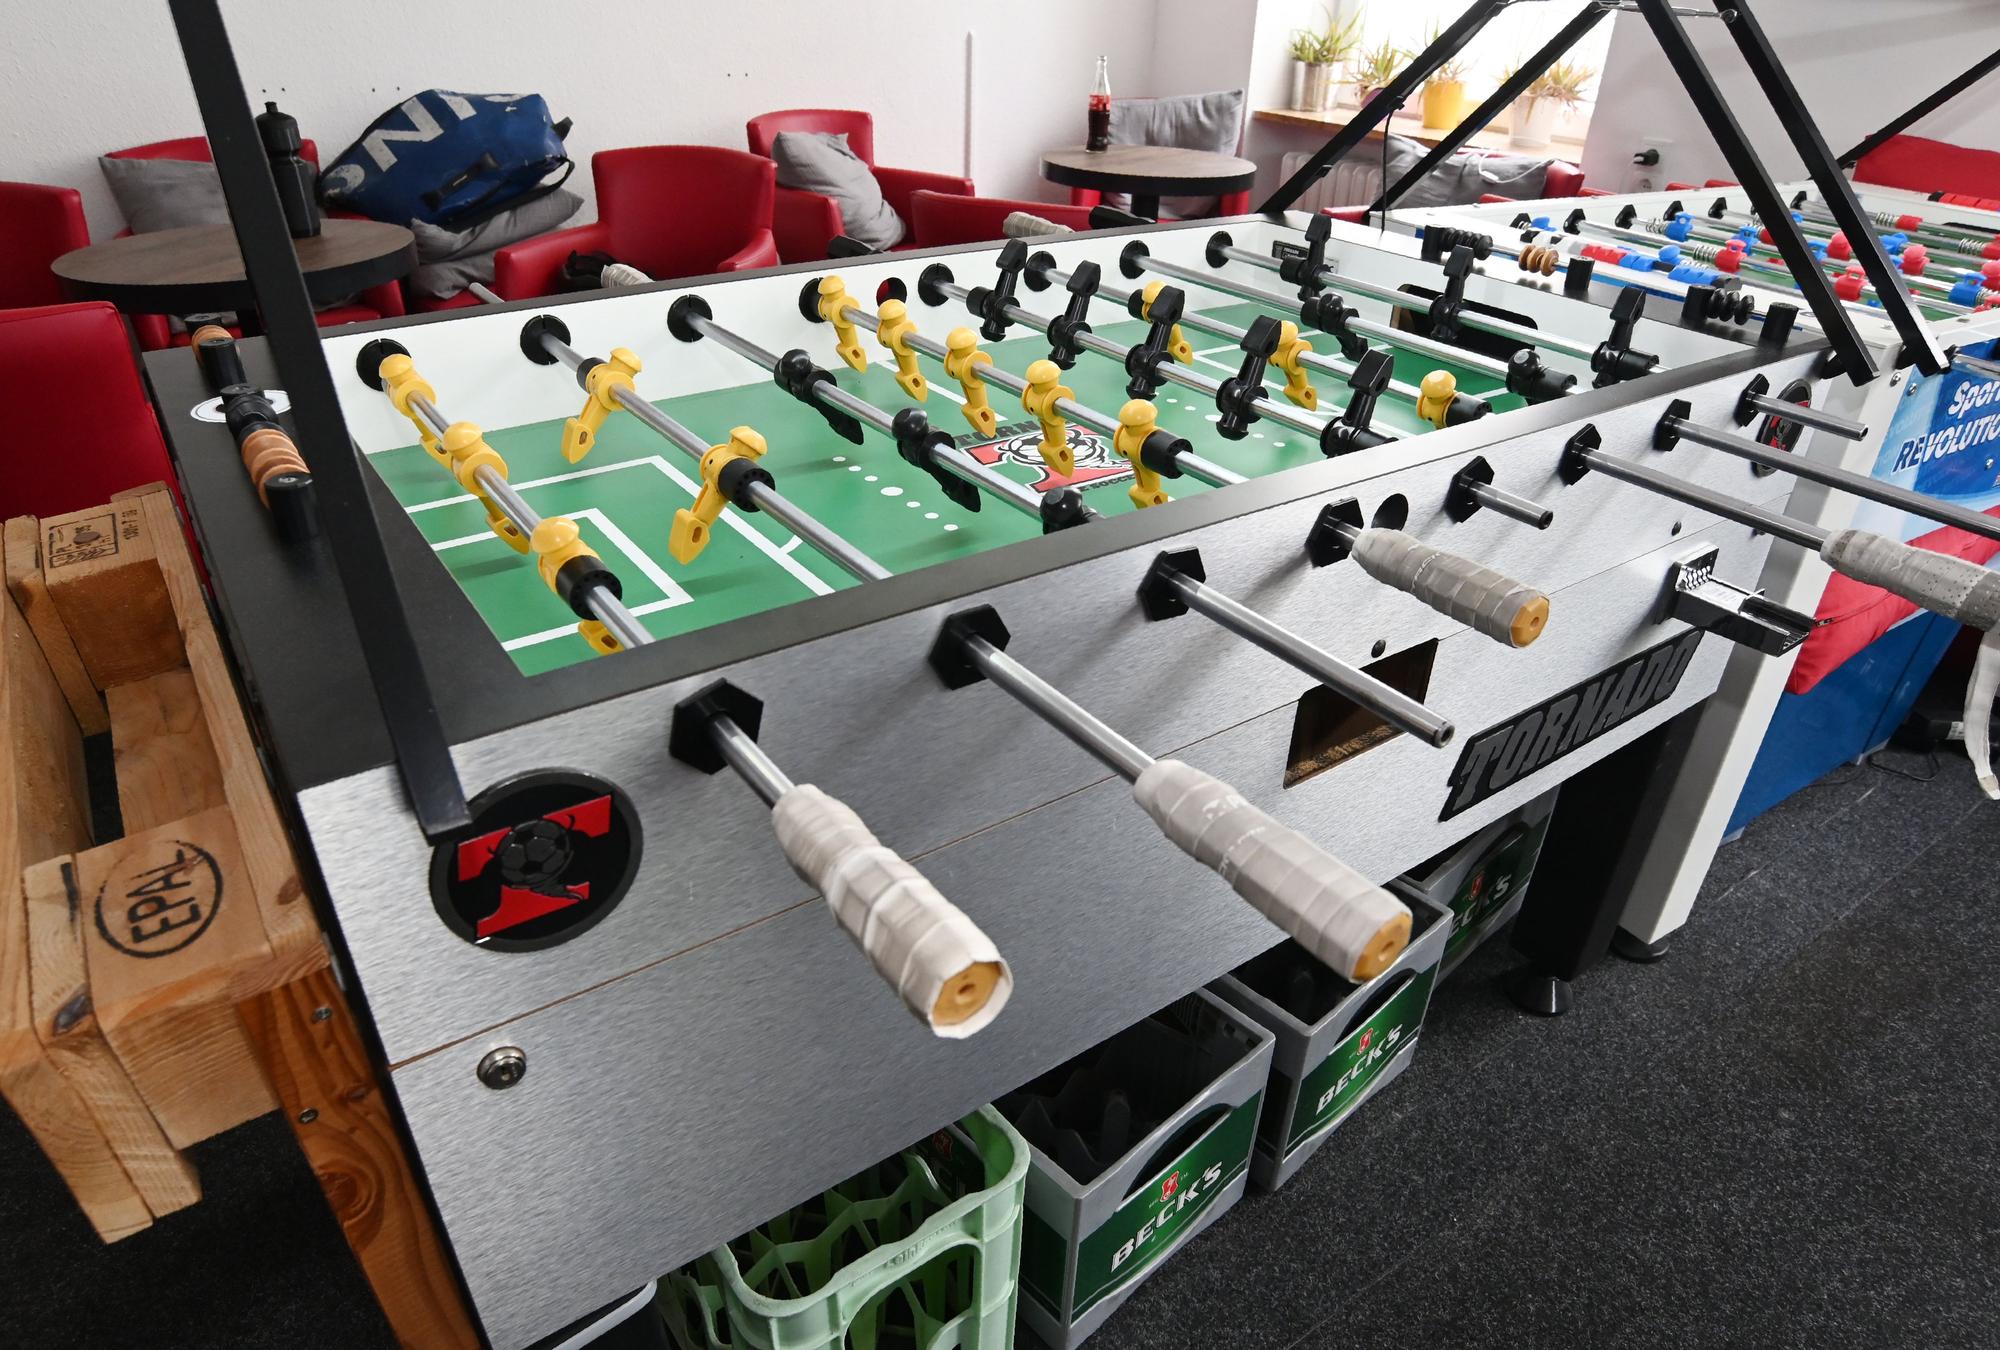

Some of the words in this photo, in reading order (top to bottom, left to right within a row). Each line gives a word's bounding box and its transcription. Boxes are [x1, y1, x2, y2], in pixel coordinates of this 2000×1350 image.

[1452, 630, 1701, 813] TORNADO
[126, 848, 202, 944] EPAL
[1315, 1023, 1403, 1116] BECK'S
[1110, 1160, 1222, 1273] BECK'S
